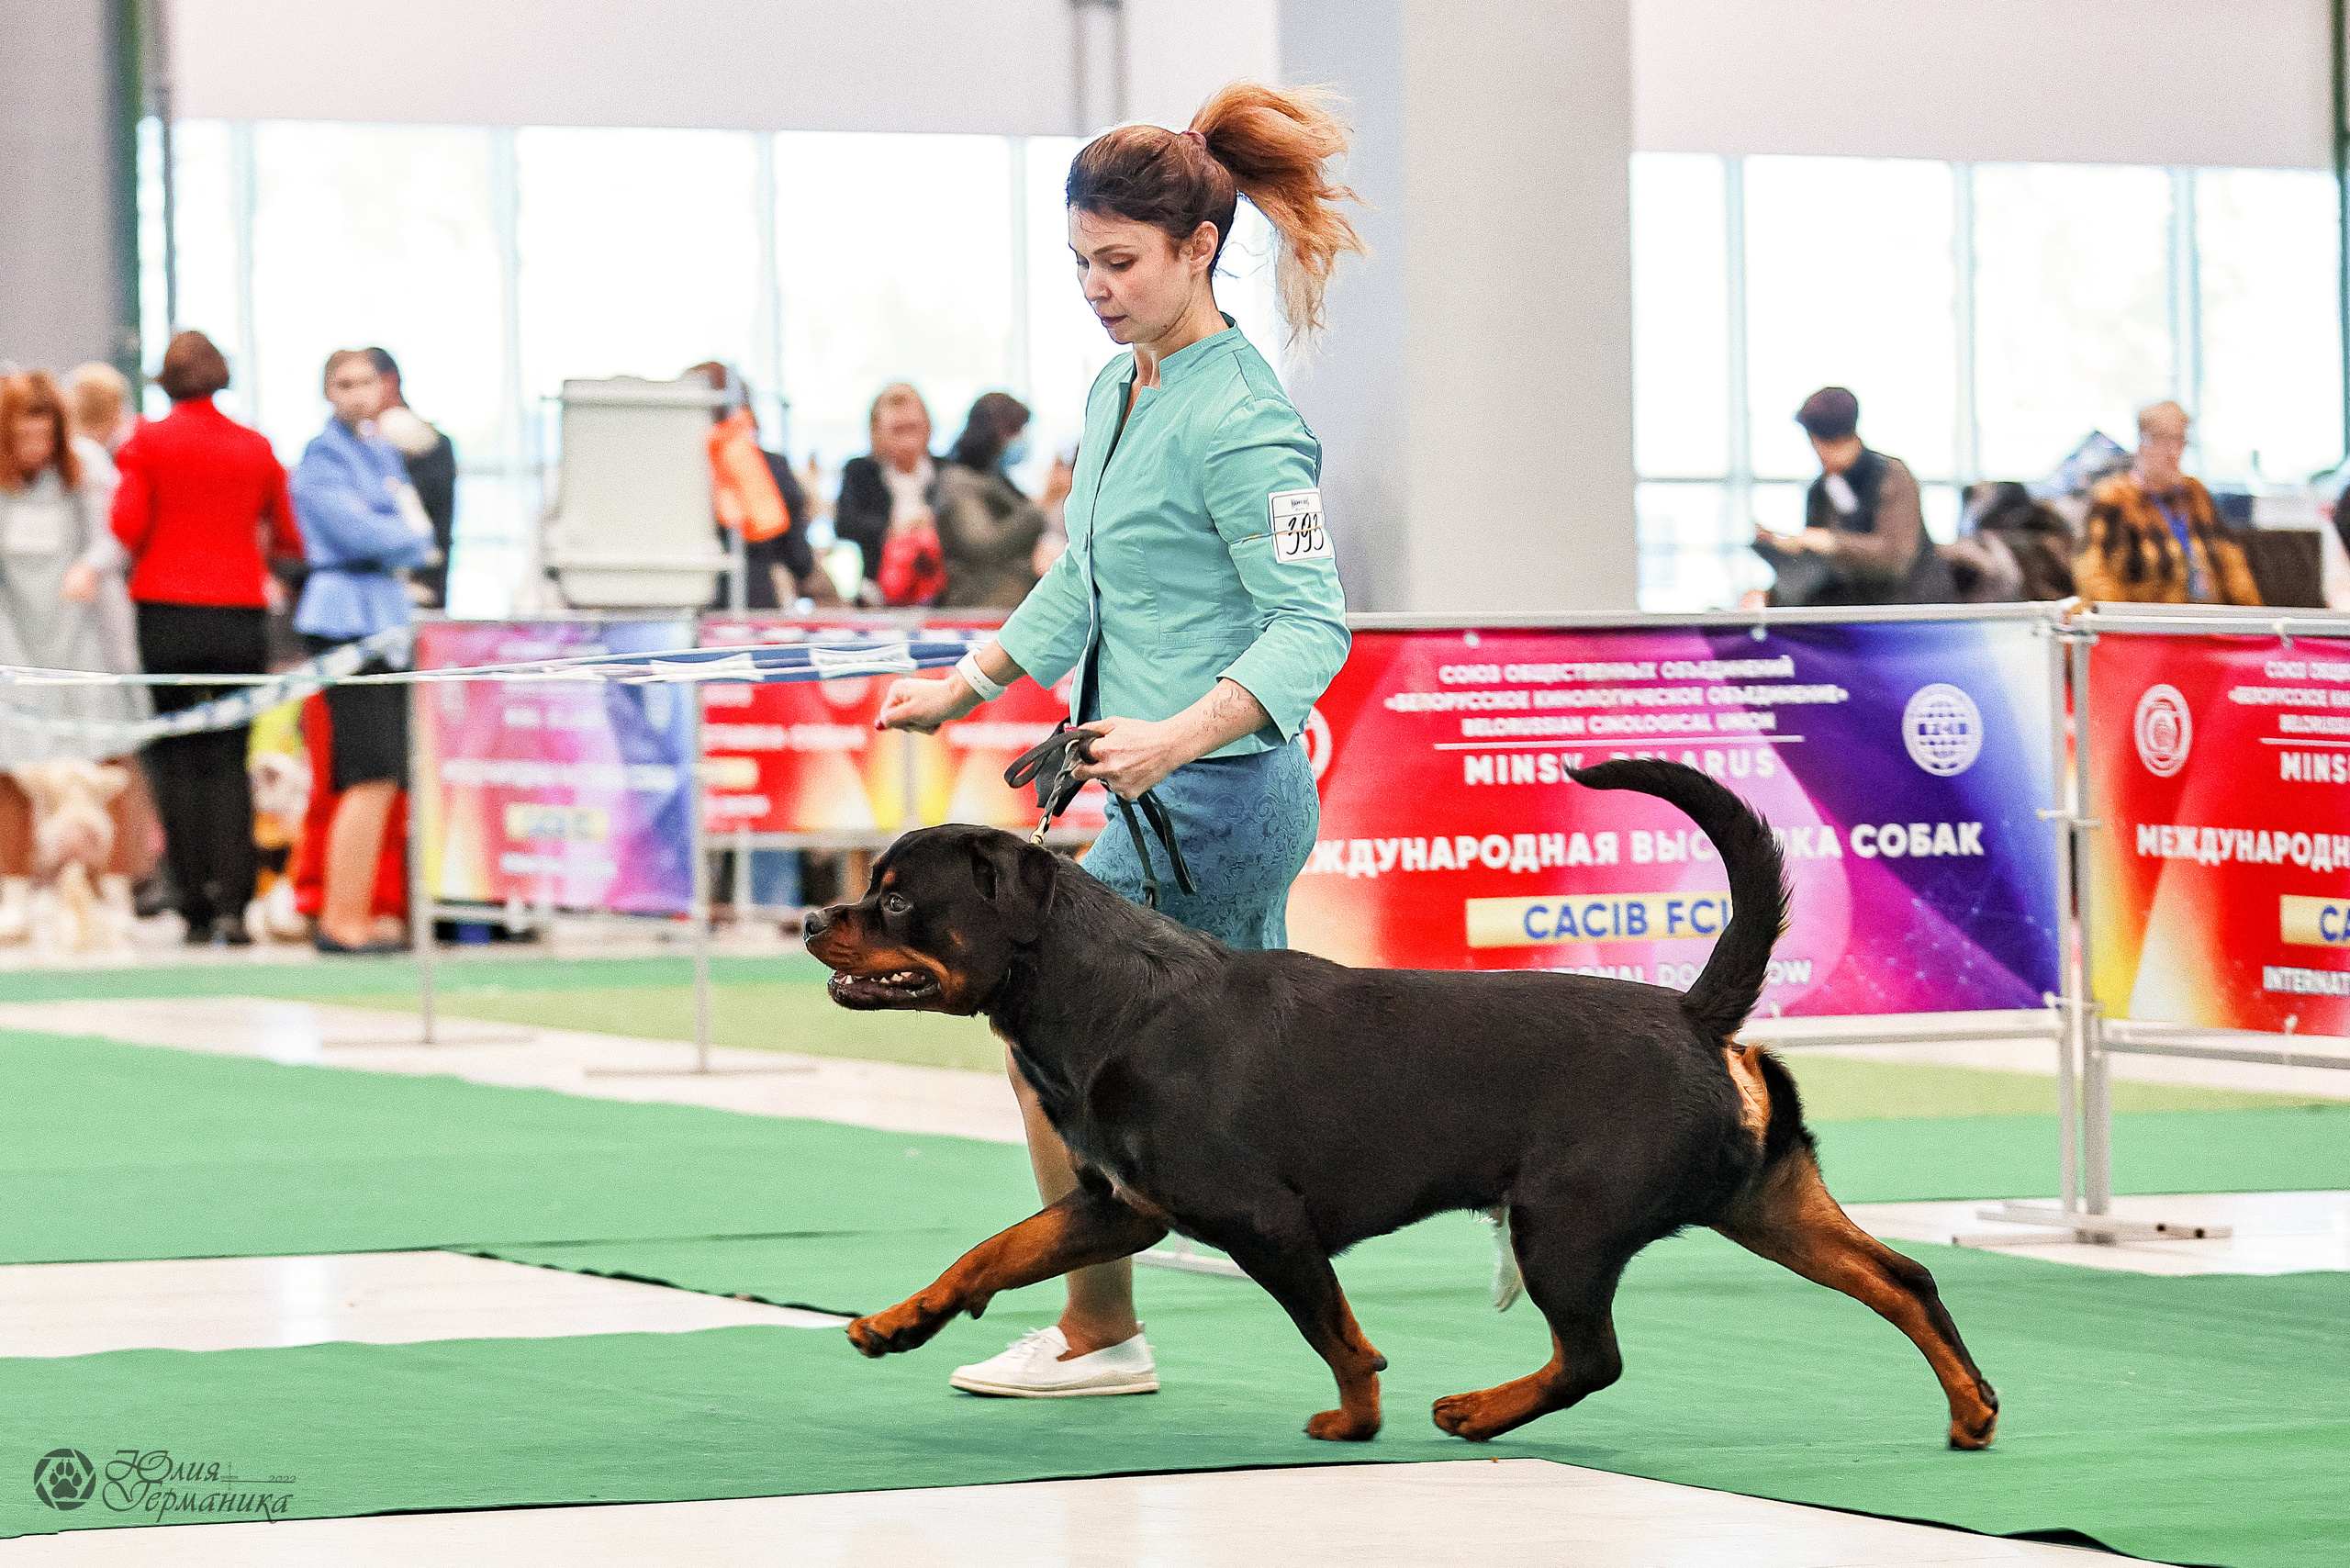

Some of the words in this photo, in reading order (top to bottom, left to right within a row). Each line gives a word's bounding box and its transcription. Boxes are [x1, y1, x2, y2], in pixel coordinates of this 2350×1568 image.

[1609, 748, 1776, 780] ARUS
[2279, 751, 2350, 785] MINS
[1299, 830, 1619, 879] ЖДУНАРОДНАЯ
[1851, 822, 1985, 858] СОБАК
[1523, 902, 1650, 940] CACIB
[1667, 899, 1729, 935] FCI
